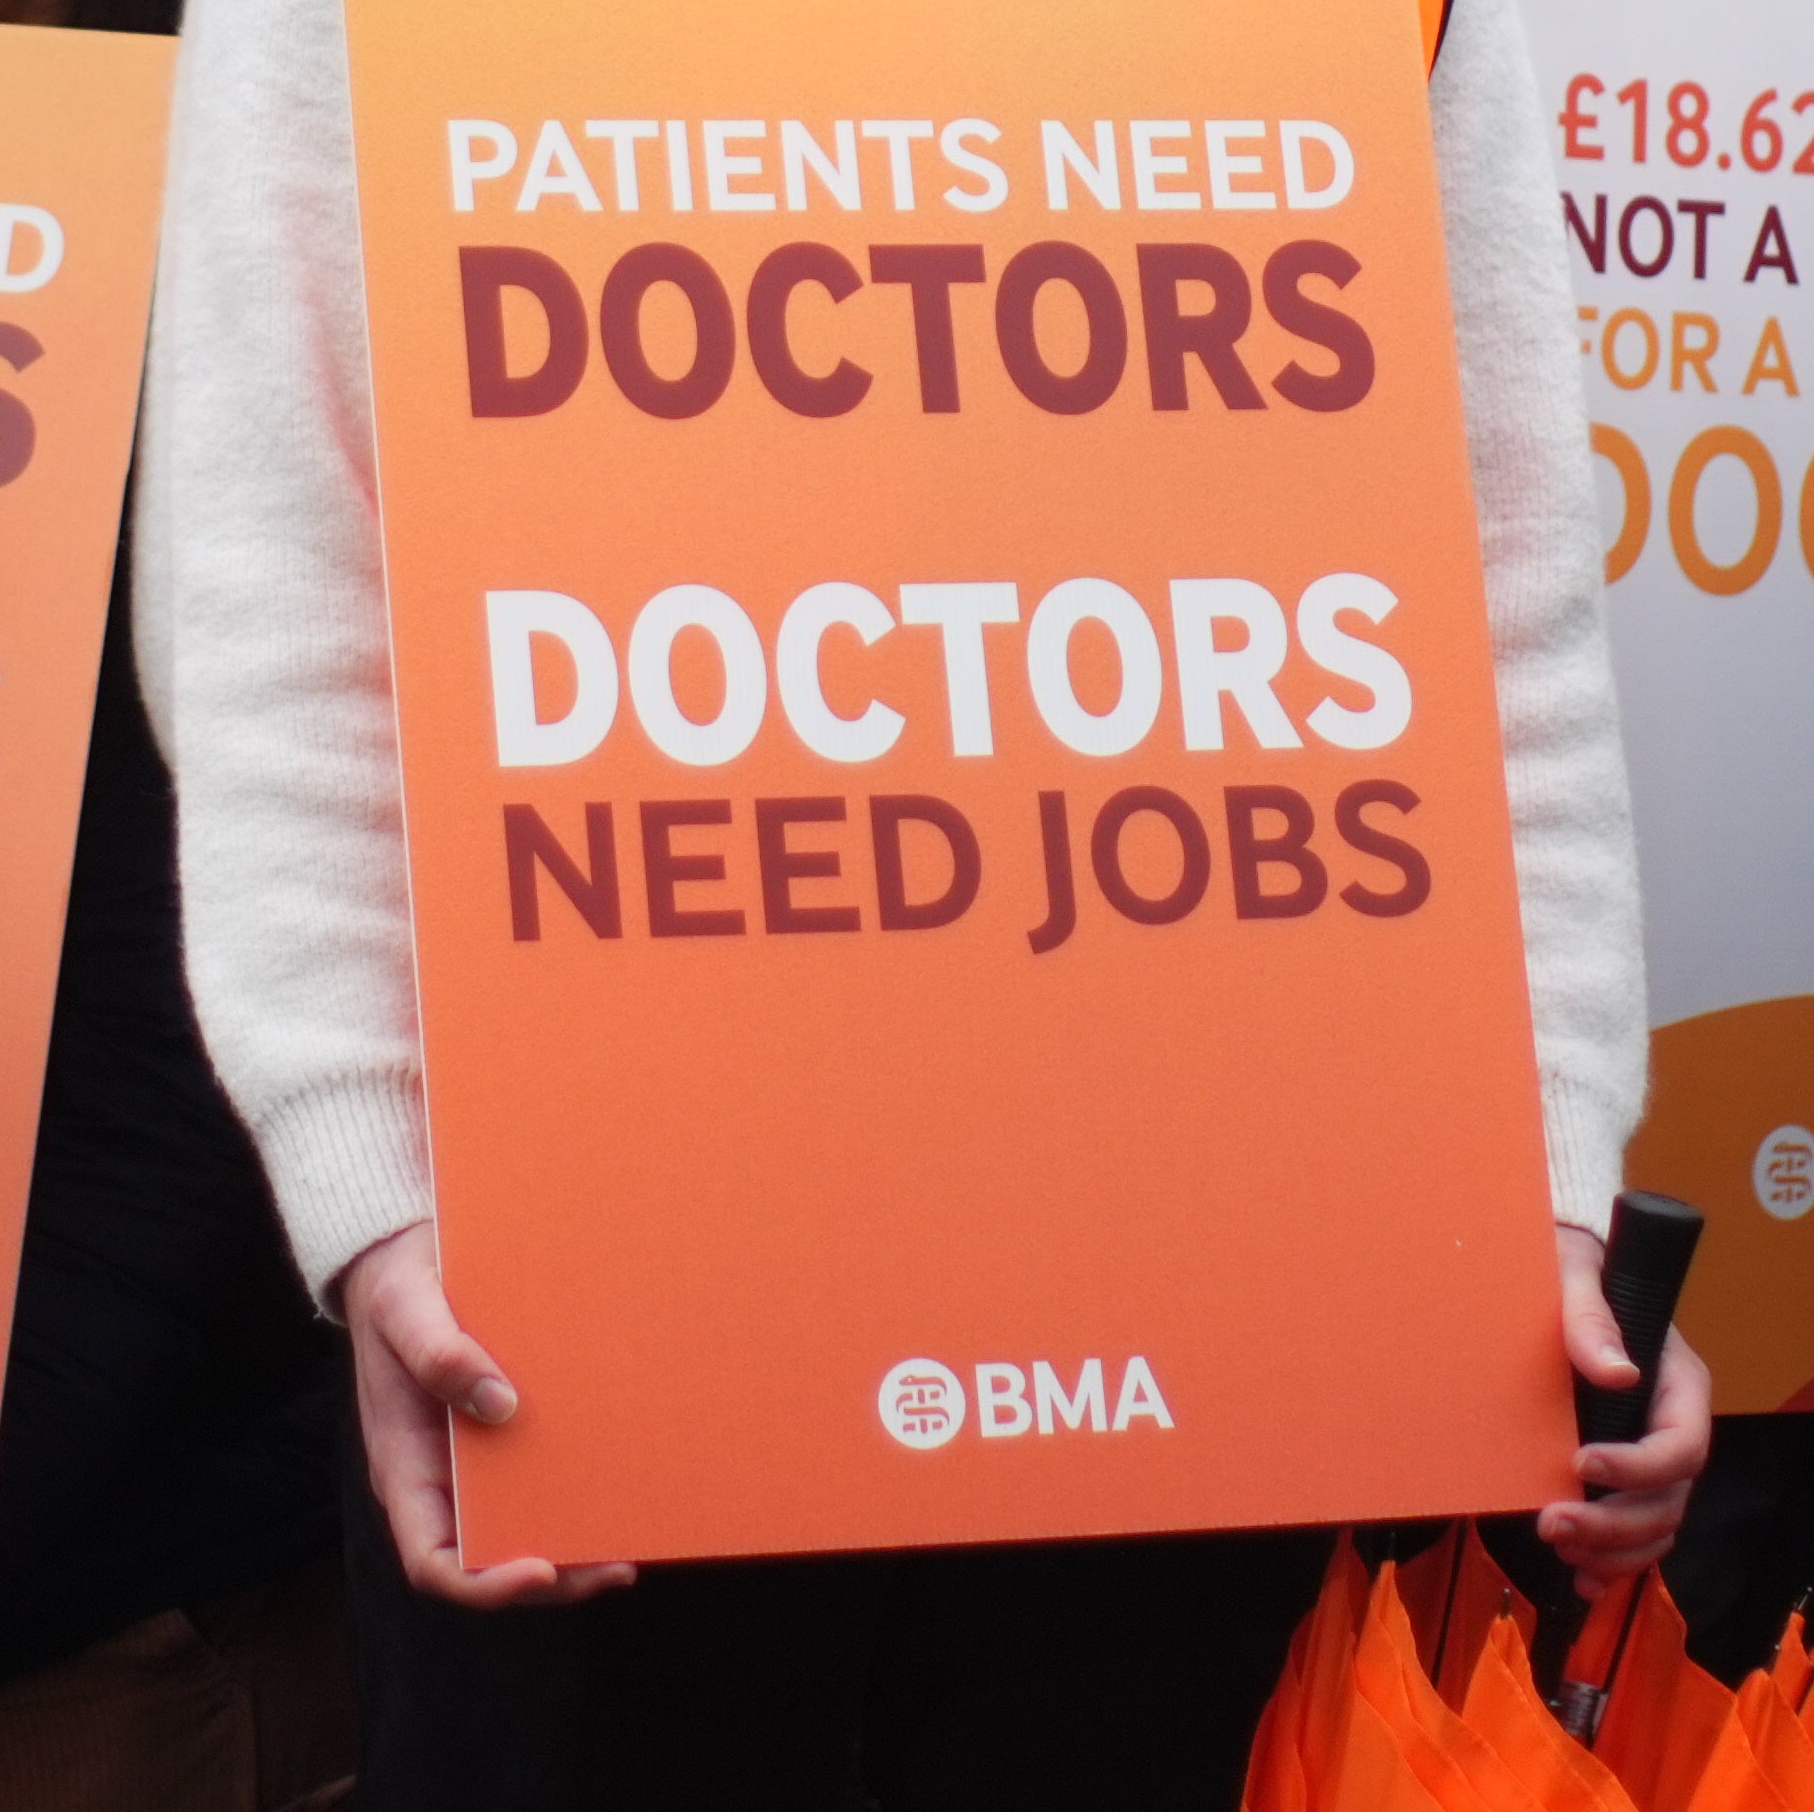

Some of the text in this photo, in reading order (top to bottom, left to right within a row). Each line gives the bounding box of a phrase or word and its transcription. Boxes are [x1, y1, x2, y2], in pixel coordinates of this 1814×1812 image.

[447, 118, 1356, 213] PATIENTS NEED
[1560, 190, 1726, 280] NOT
[1743, 204, 1800, 286] A
[458, 239, 1376, 420] DOCTORS
[1743, 317, 1800, 398] A
[485, 572, 1413, 769] DOCTORS
[502, 778, 1433, 956] NEED JOBS
[975, 1355, 1175, 1438] BMA
